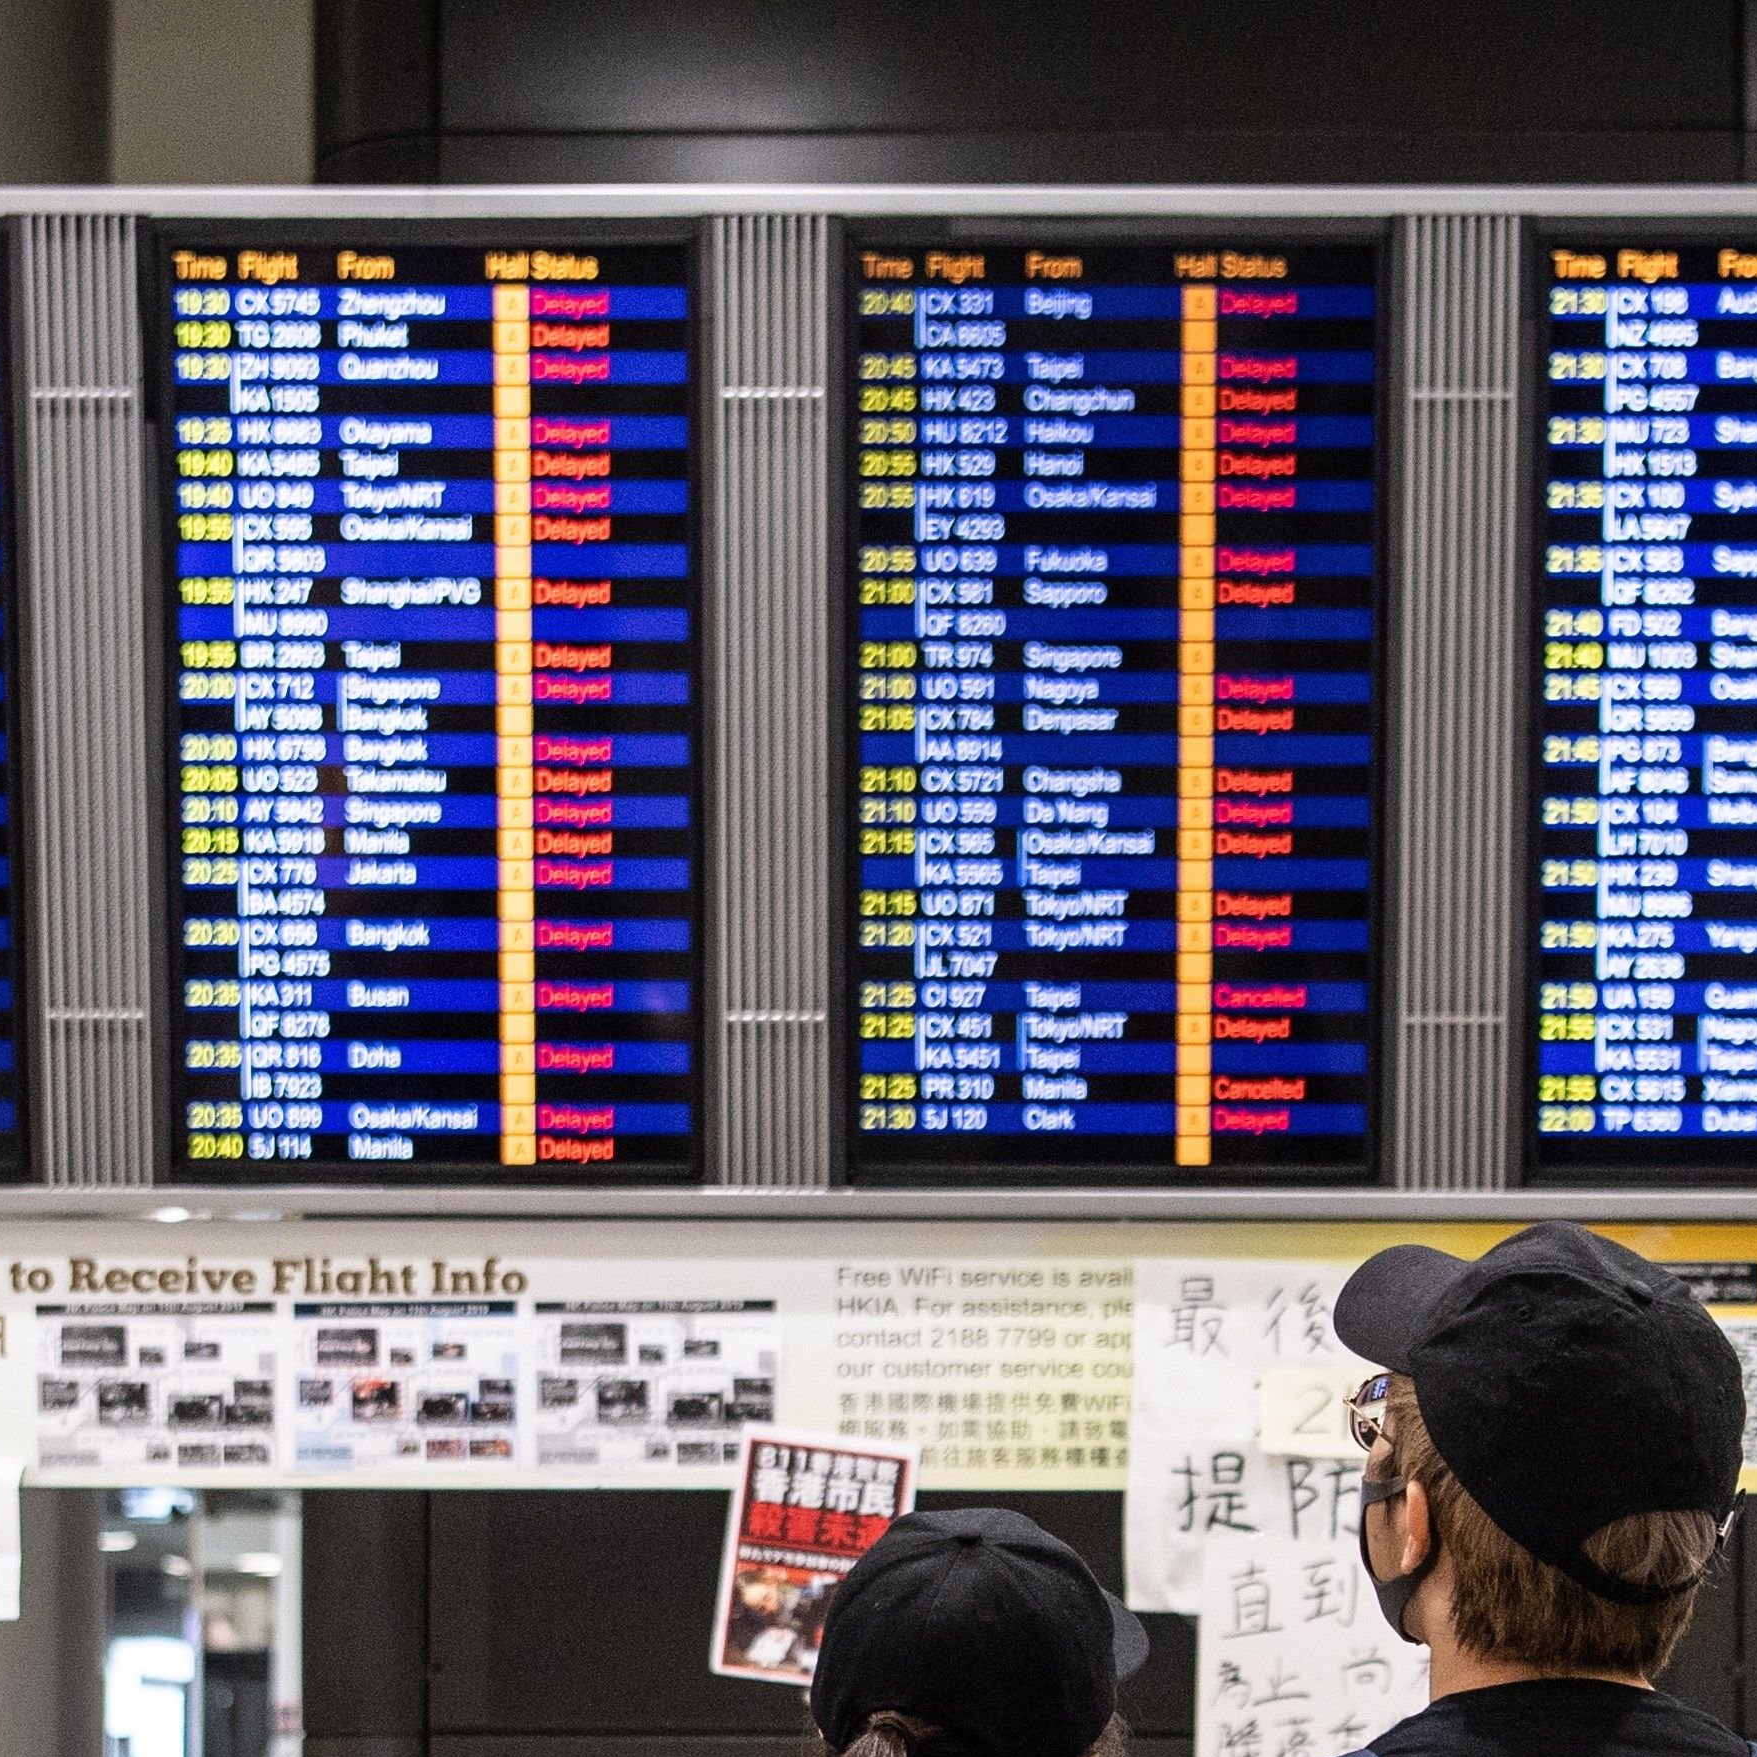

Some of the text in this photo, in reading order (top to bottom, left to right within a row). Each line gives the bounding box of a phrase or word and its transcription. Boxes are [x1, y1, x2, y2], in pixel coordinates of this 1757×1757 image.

[174, 252, 227, 280] Time
[238, 252, 298, 283] Flight
[338, 252, 394, 279] From
[531, 253, 598, 280] Status
[1217, 709, 1294, 735] Delayed
[347, 736, 428, 766] Bangkok
[346, 769, 447, 793] Takamatsu
[537, 769, 612, 796] Delayed
[346, 799, 442, 827] Singapore
[347, 830, 411, 855] Manila
[347, 860, 417, 886] Jakarta
[348, 923, 430, 951] Bangkok
[349, 983, 410, 1008] Busan
[1215, 985, 1307, 1010] Cancelled
[349, 1045, 402, 1070] Doha
[349, 1106, 478, 1132] Osaka/Kansai
[1023, 1107, 1076, 1131] Clark
[188, 1135, 243, 1160] 20:40
[349, 1136, 413, 1160] Manila
[537, 1139, 613, 1164] Delayed
[9, 1262, 53, 1296] to
[67, 1258, 257, 1296] Receive
[271, 1259, 420, 1300] Flight
[431, 1258, 529, 1296] Info
[837, 1267, 891, 1288] Free
[899, 1266, 953, 1287] WiFi
[960, 1268, 1045, 1288] service
[1052, 1268, 1071, 1287] is
[915, 1298, 953, 1316] For
[962, 1298, 1093, 1319] assistance,
[837, 1328, 921, 1348] contact
[931, 1328, 989, 1348] 2188
[997, 1328, 1057, 1348] 7799
[1065, 1332, 1087, 1348] or
[837, 1362, 875, 1378] our
[883, 1360, 992, 1378] customer
[1001, 1360, 1084, 1378] service
[751, 1466, 897, 1518] 香港市民
